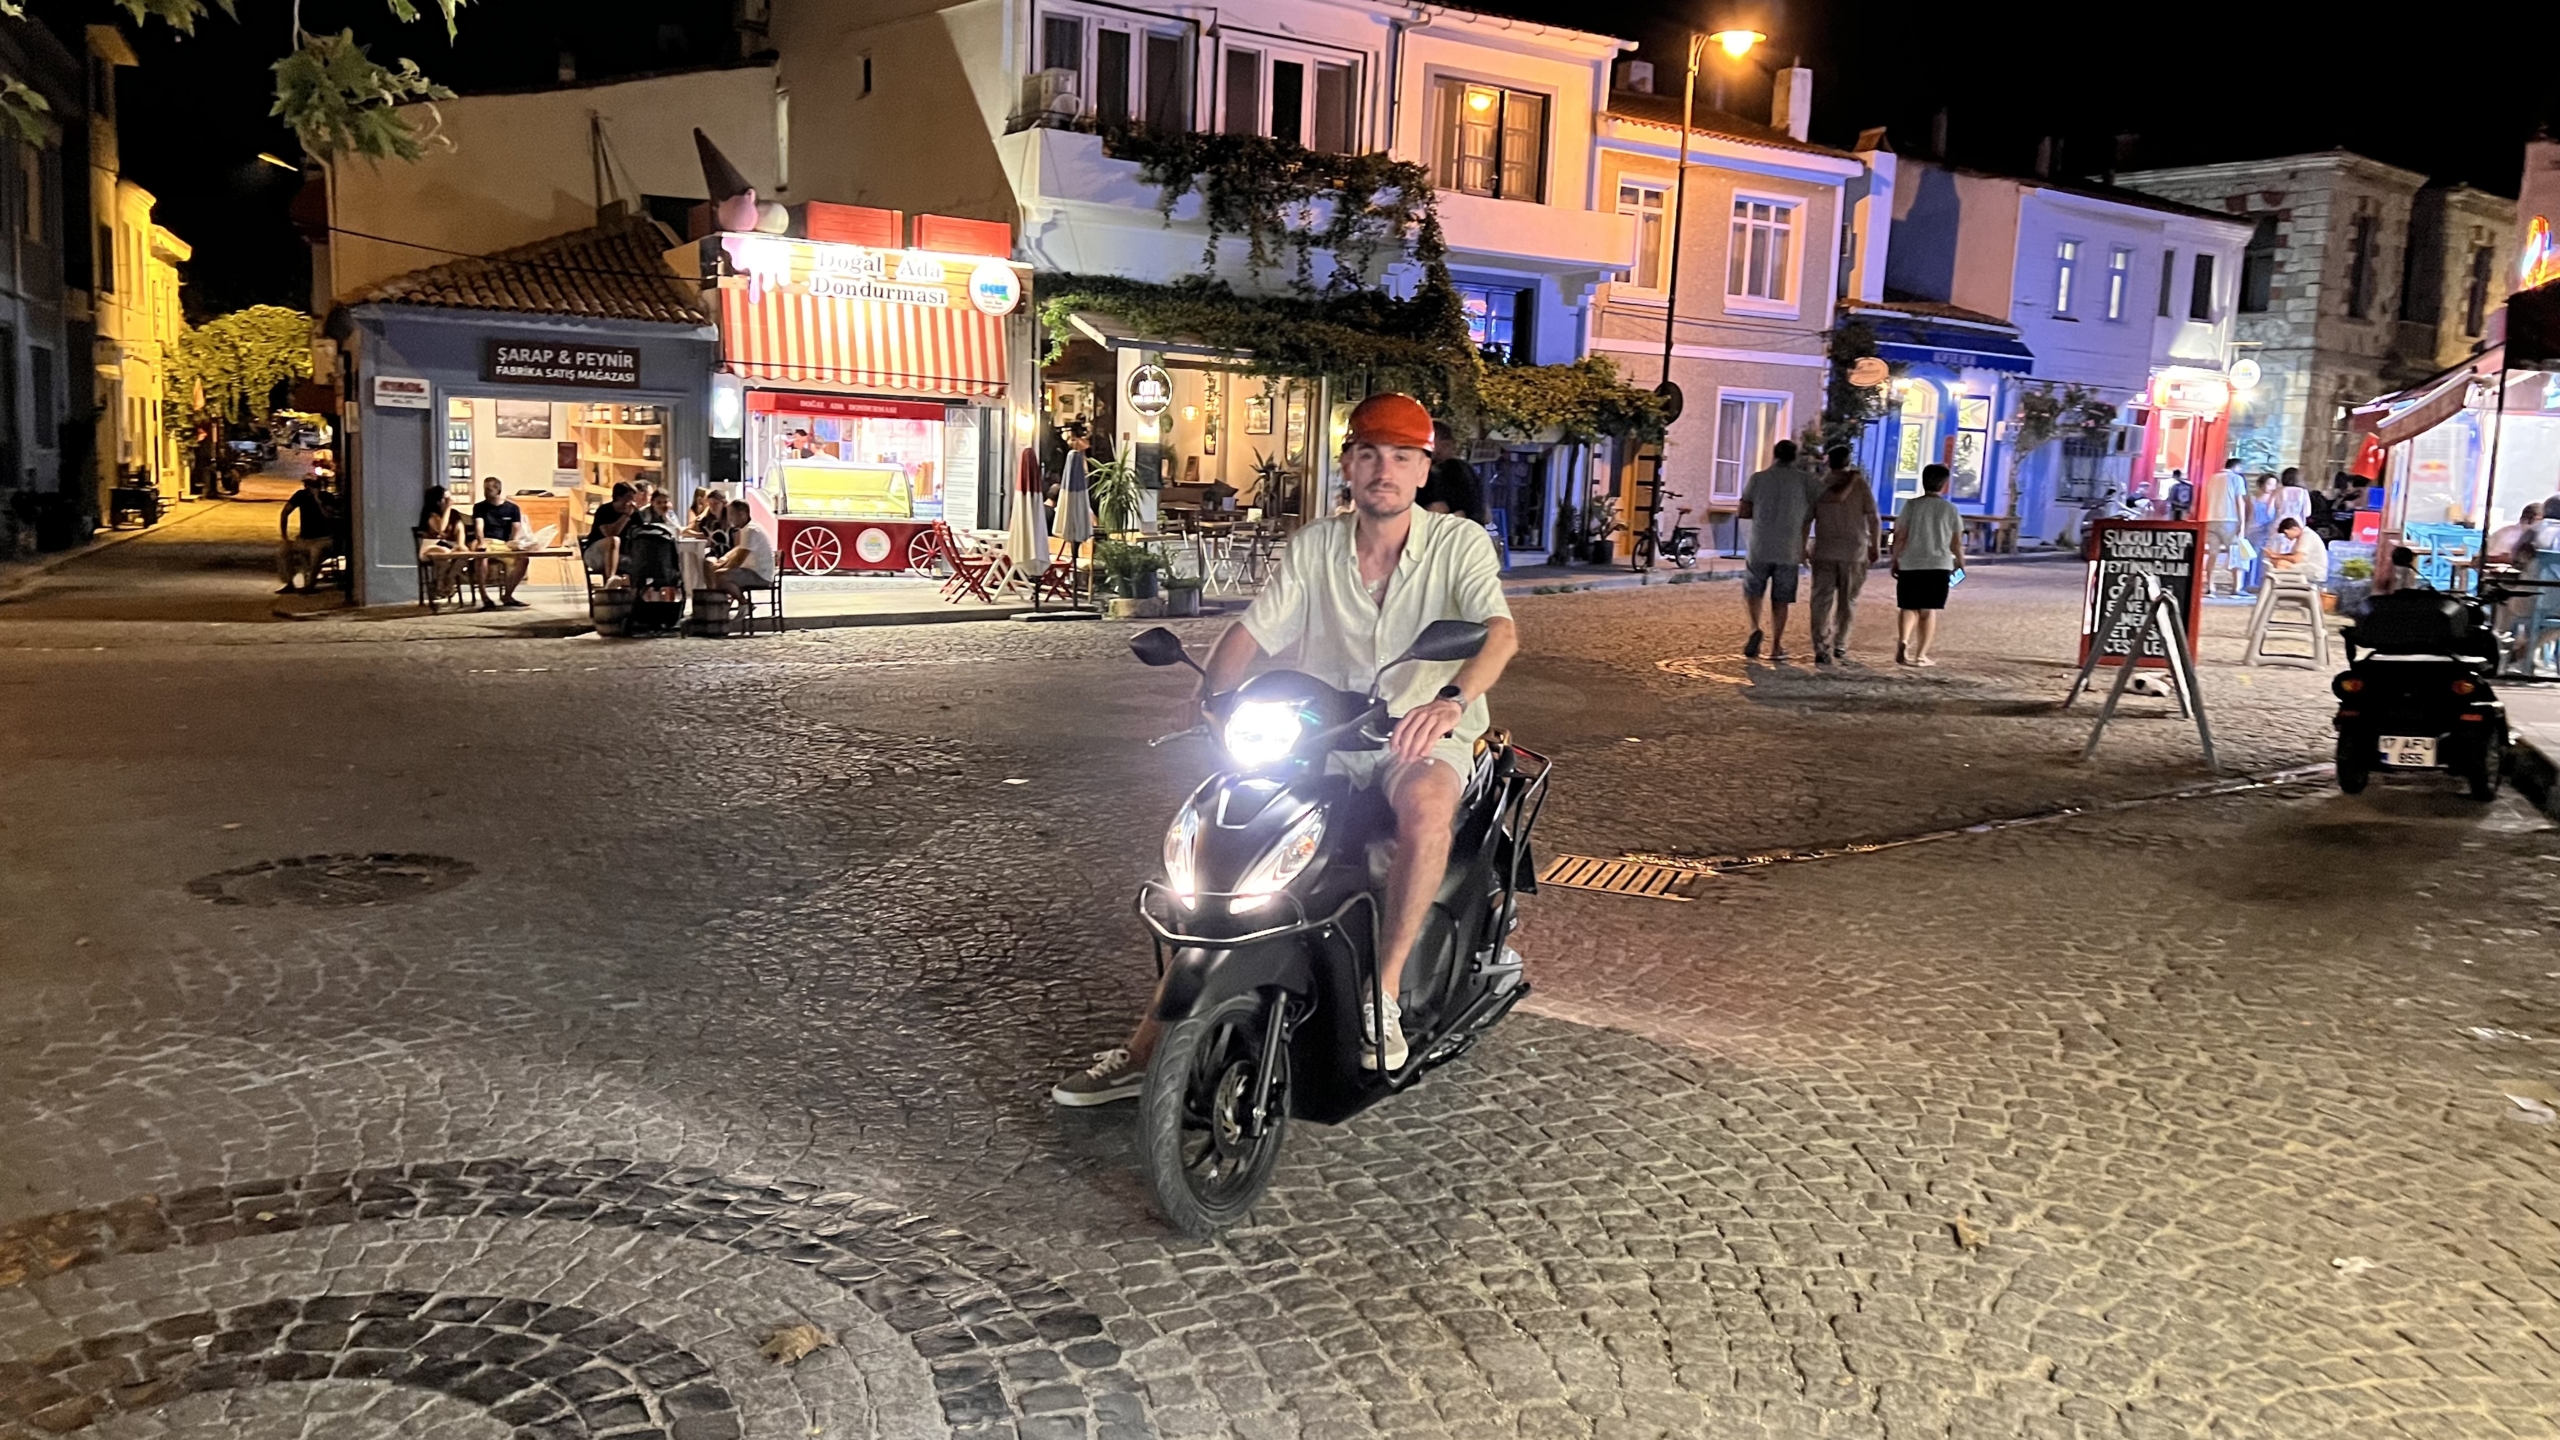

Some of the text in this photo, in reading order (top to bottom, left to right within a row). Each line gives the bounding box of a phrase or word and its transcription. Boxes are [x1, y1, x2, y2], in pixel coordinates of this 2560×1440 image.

[819, 251, 941, 279] Doğal Ada
[813, 277, 946, 305] Dondurması
[497, 347, 634, 368] ŞARAP & PEYNİR
[495, 365, 635, 382] FABRİKA SATIŞ MAĞAZASI
[800, 399, 826, 409] DOĞAL
[829, 402, 845, 411] ADA
